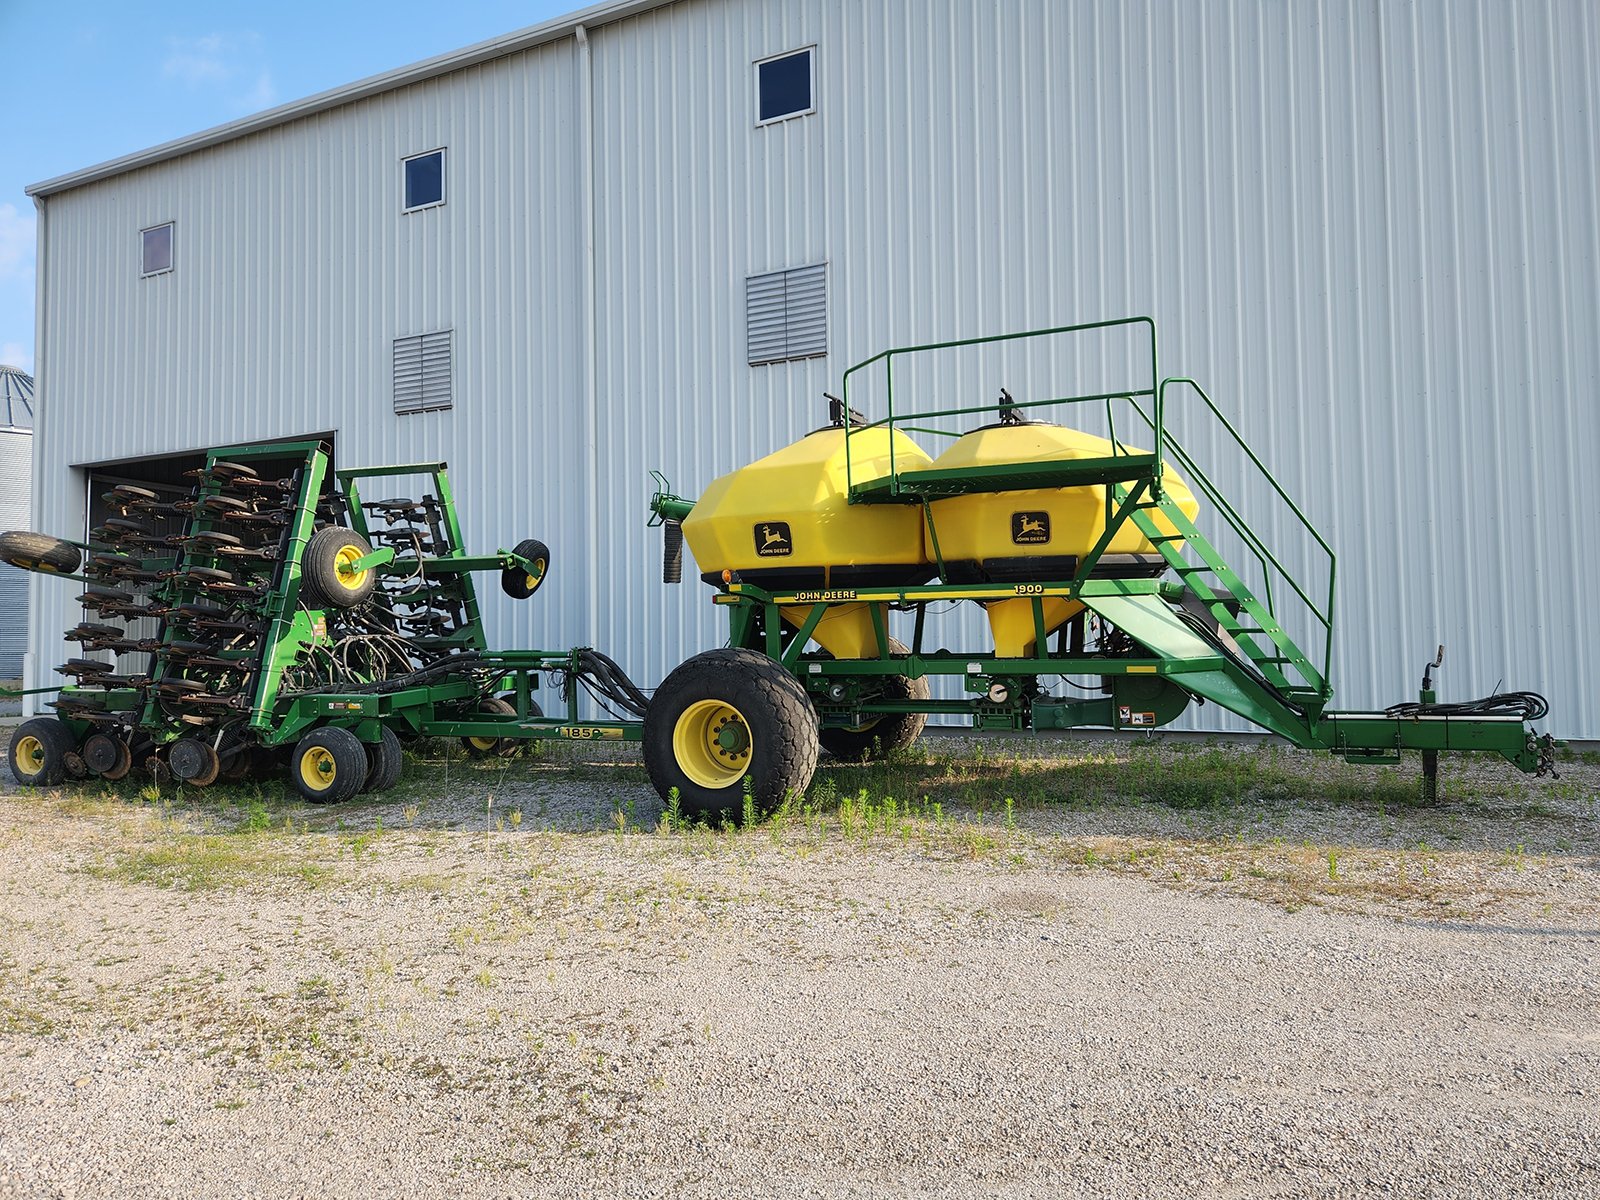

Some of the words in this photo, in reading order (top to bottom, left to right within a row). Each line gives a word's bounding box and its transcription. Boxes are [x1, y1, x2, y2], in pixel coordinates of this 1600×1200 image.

[1014, 584, 1043, 594] 1900
[794, 592, 821, 600] JOHN
[824, 590, 856, 600] DEERE
